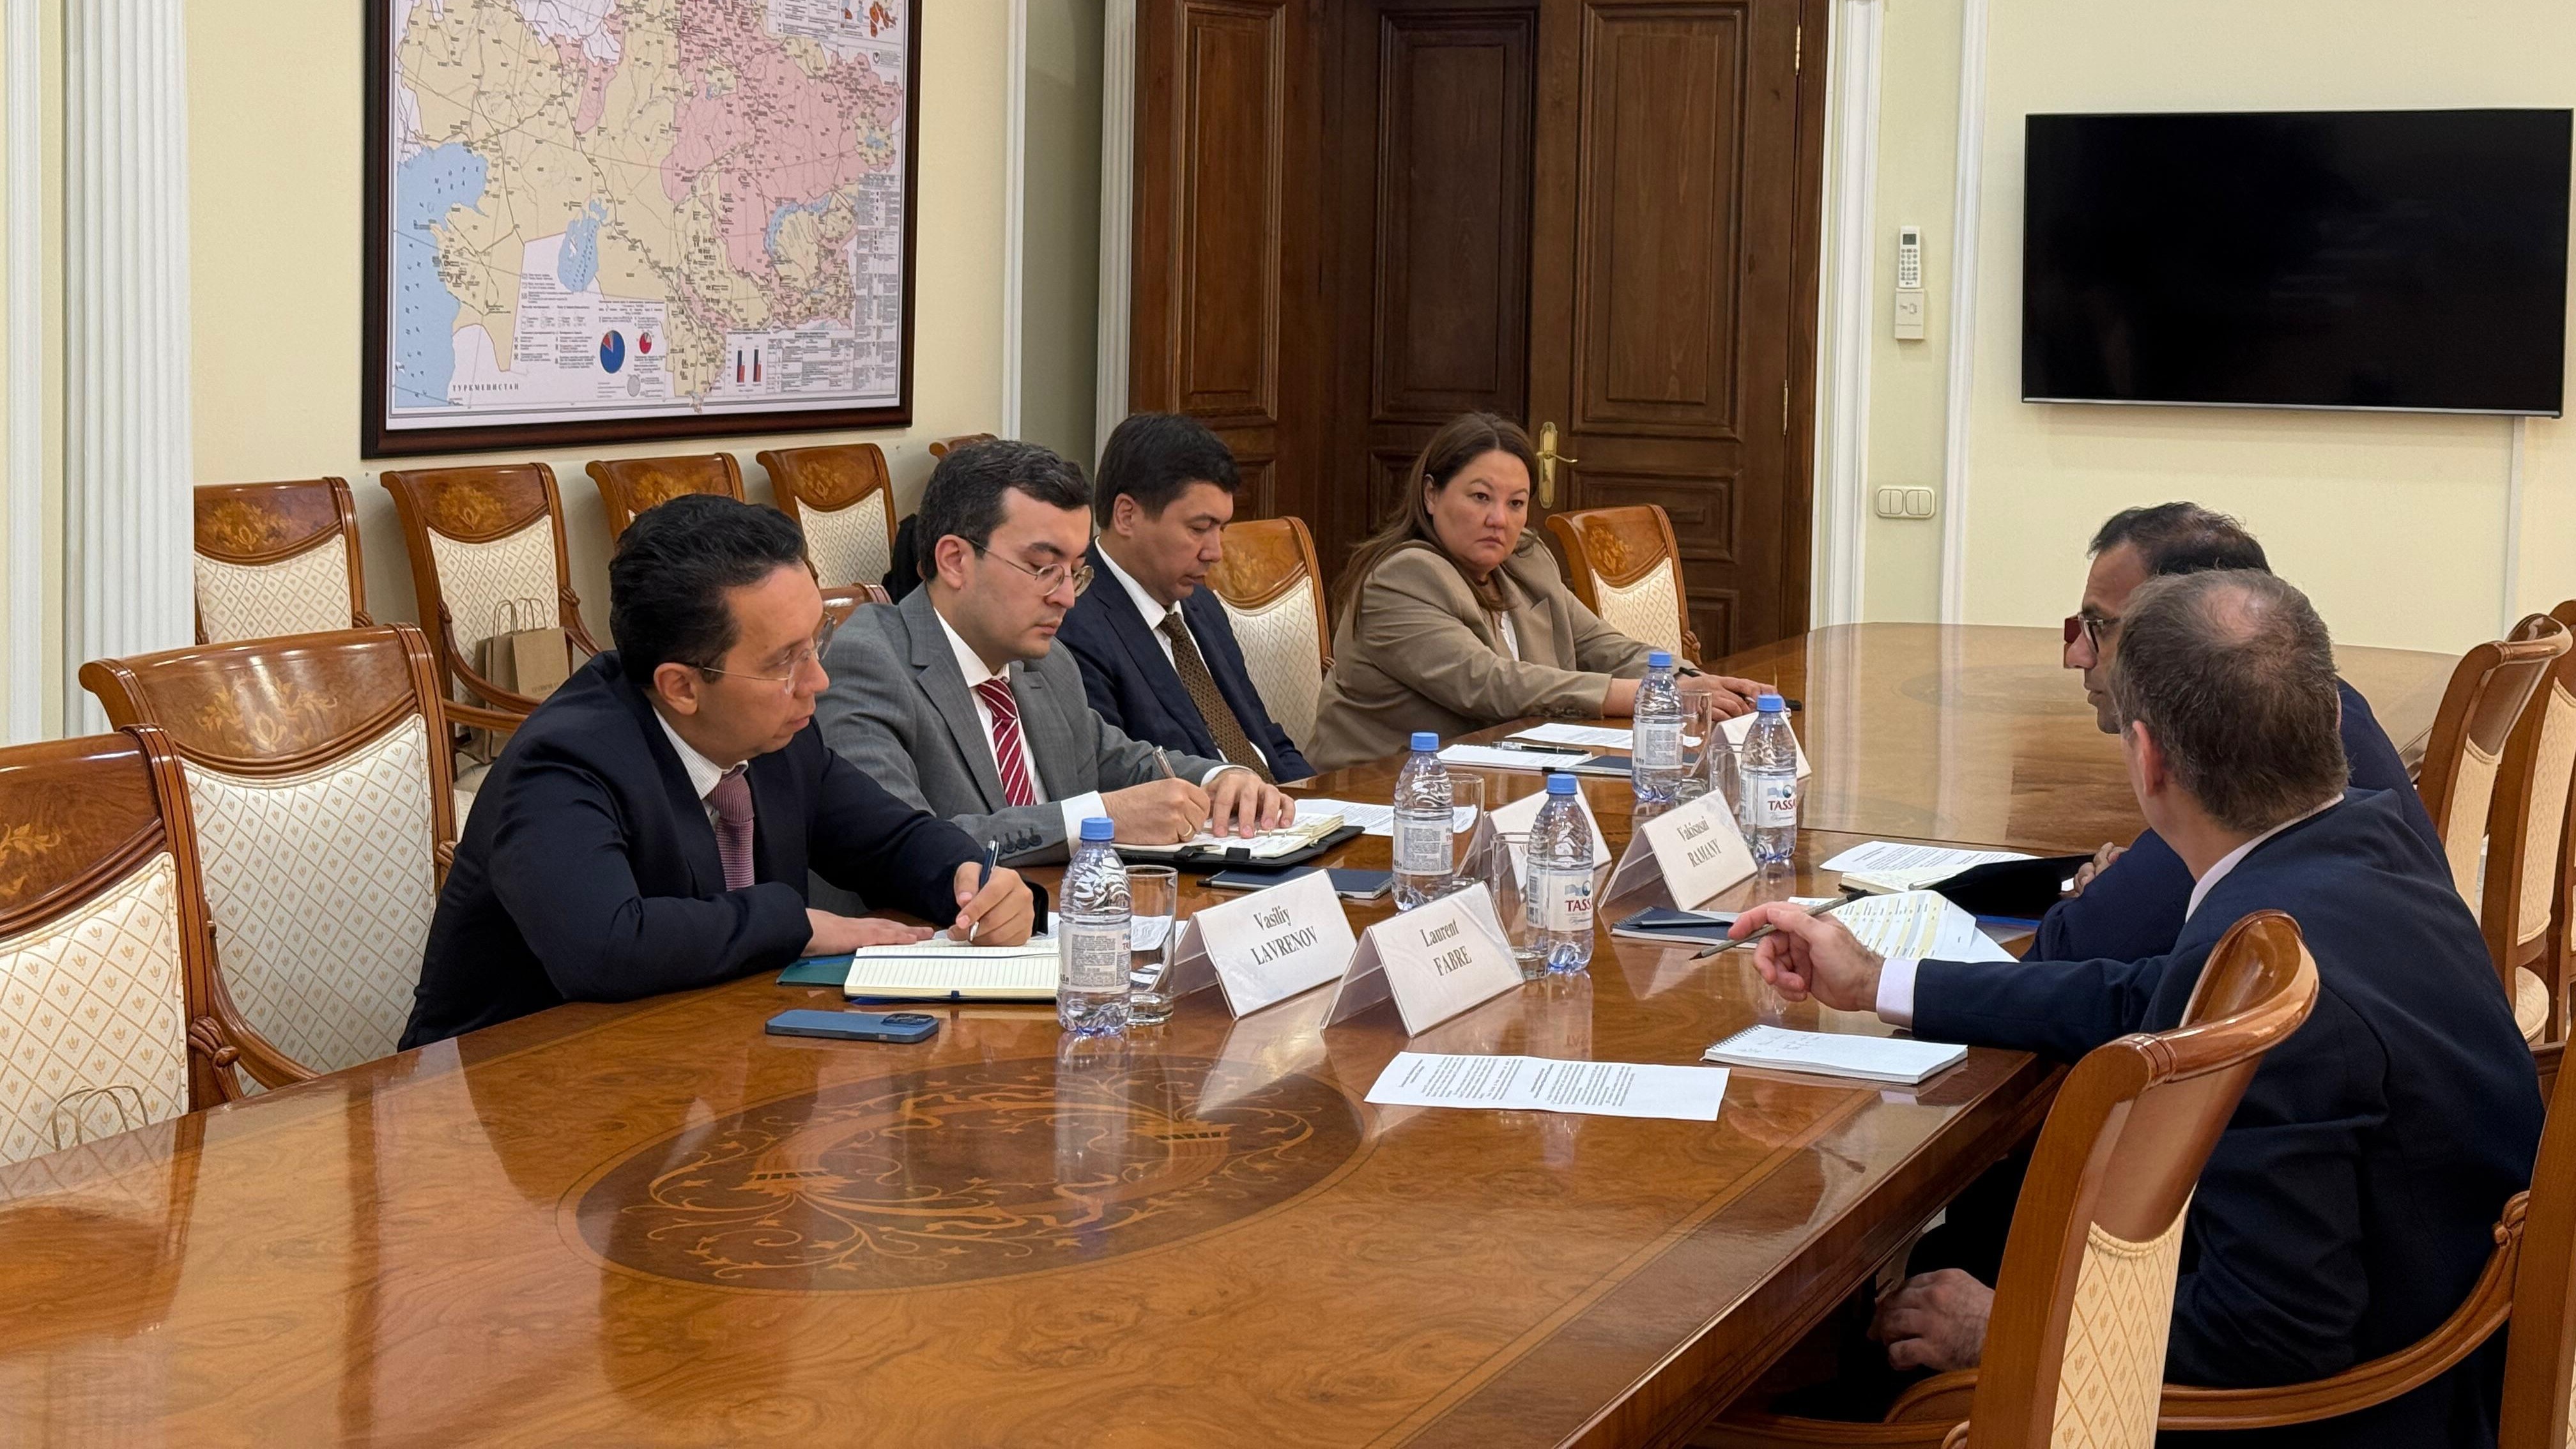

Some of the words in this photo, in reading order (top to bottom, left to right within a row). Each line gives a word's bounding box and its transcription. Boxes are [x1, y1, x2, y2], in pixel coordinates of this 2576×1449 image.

[1687, 838, 1722, 868] RAMANY
[1253, 905, 1292, 931] Vasiliy
[1420, 917, 1460, 947] Laurent
[1250, 926, 1318, 965] LAVRENOV
[1433, 946, 1473, 976] FABRE
